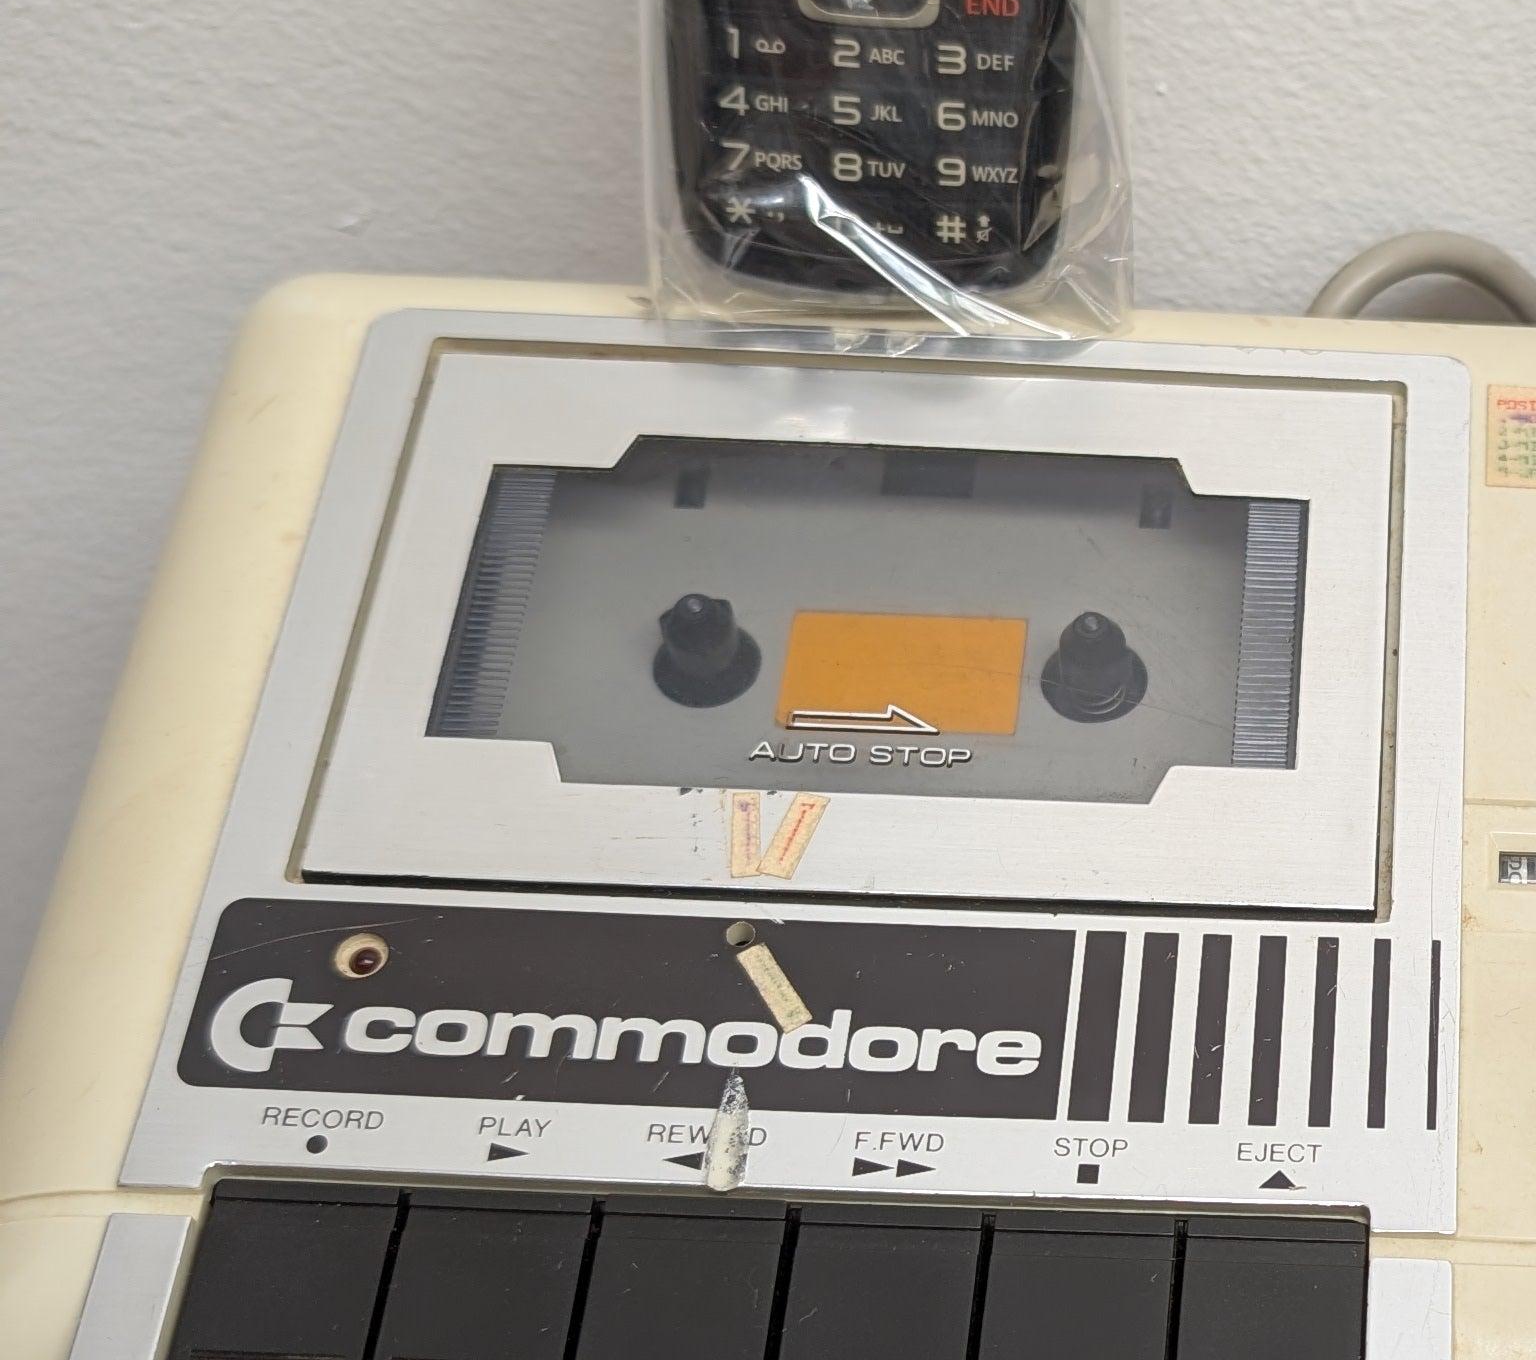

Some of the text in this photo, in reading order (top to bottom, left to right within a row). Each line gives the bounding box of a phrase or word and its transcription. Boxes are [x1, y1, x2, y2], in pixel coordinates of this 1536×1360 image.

[726, 28, 740, 59] 1
[832, 39, 905, 68] 2 ABC
[937, 45, 1014, 74] 3 DEF
[719, 87, 788, 115] 4 GHI
[833, 96, 902, 126] 5 JKL
[937, 102, 1018, 131] 6 MNO
[721, 143, 802, 171] 7 PQRS
[833, 154, 905, 181] 8 TUV
[937, 157, 1018, 187] 9 WXYZ
[936, 215, 966, 244] #
[750, 741, 973, 768] AUTO STOP
[341, 1006, 1042, 1077] commodore
[261, 1106, 386, 1131] RECORD
[478, 1116, 552, 1139] PLAY
[646, 1123, 768, 1148] REWD
[854, 1131, 946, 1154] F.FWD
[1053, 1136, 1130, 1160] STOP
[1237, 1141, 1323, 1165] EJECT
